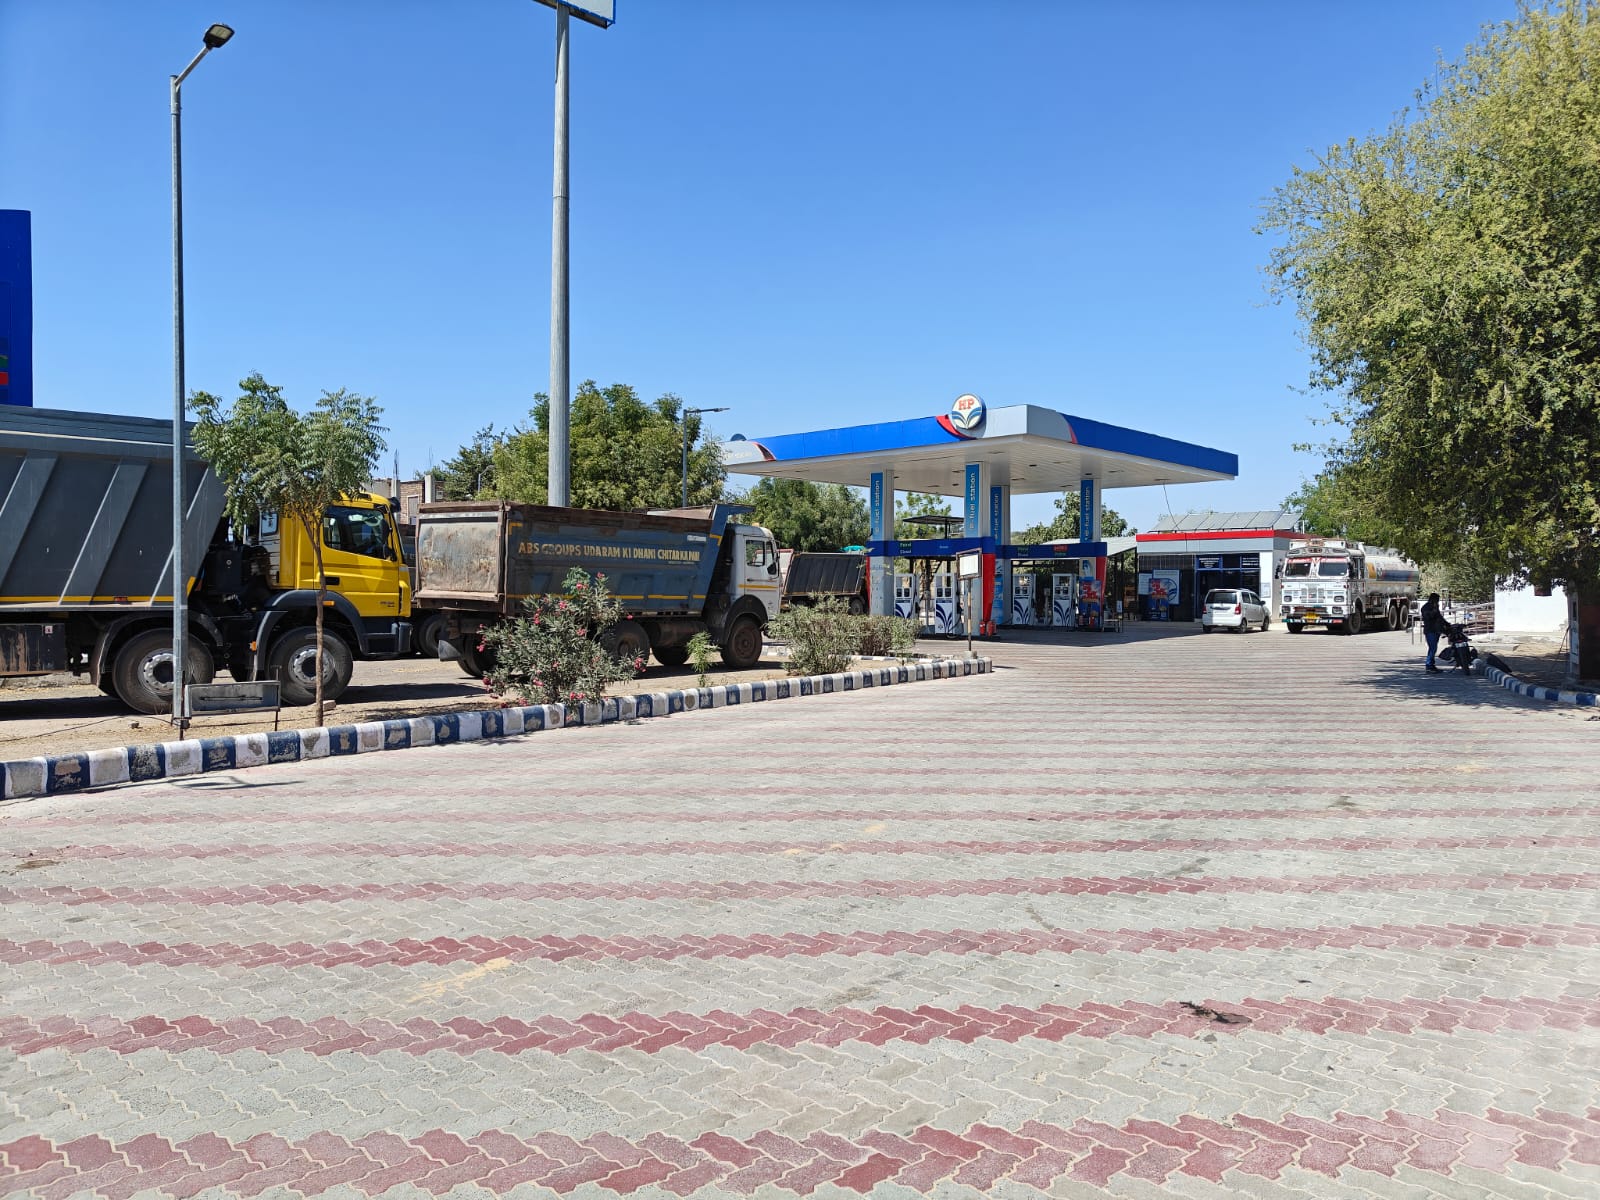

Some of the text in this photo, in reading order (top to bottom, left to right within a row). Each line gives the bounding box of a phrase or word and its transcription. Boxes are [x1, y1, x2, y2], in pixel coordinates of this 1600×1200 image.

[958, 398, 975, 410] HP
[518, 542, 540, 554] ABS
[583, 545, 620, 558] UDARAM
[622, 547, 632, 559] KI
